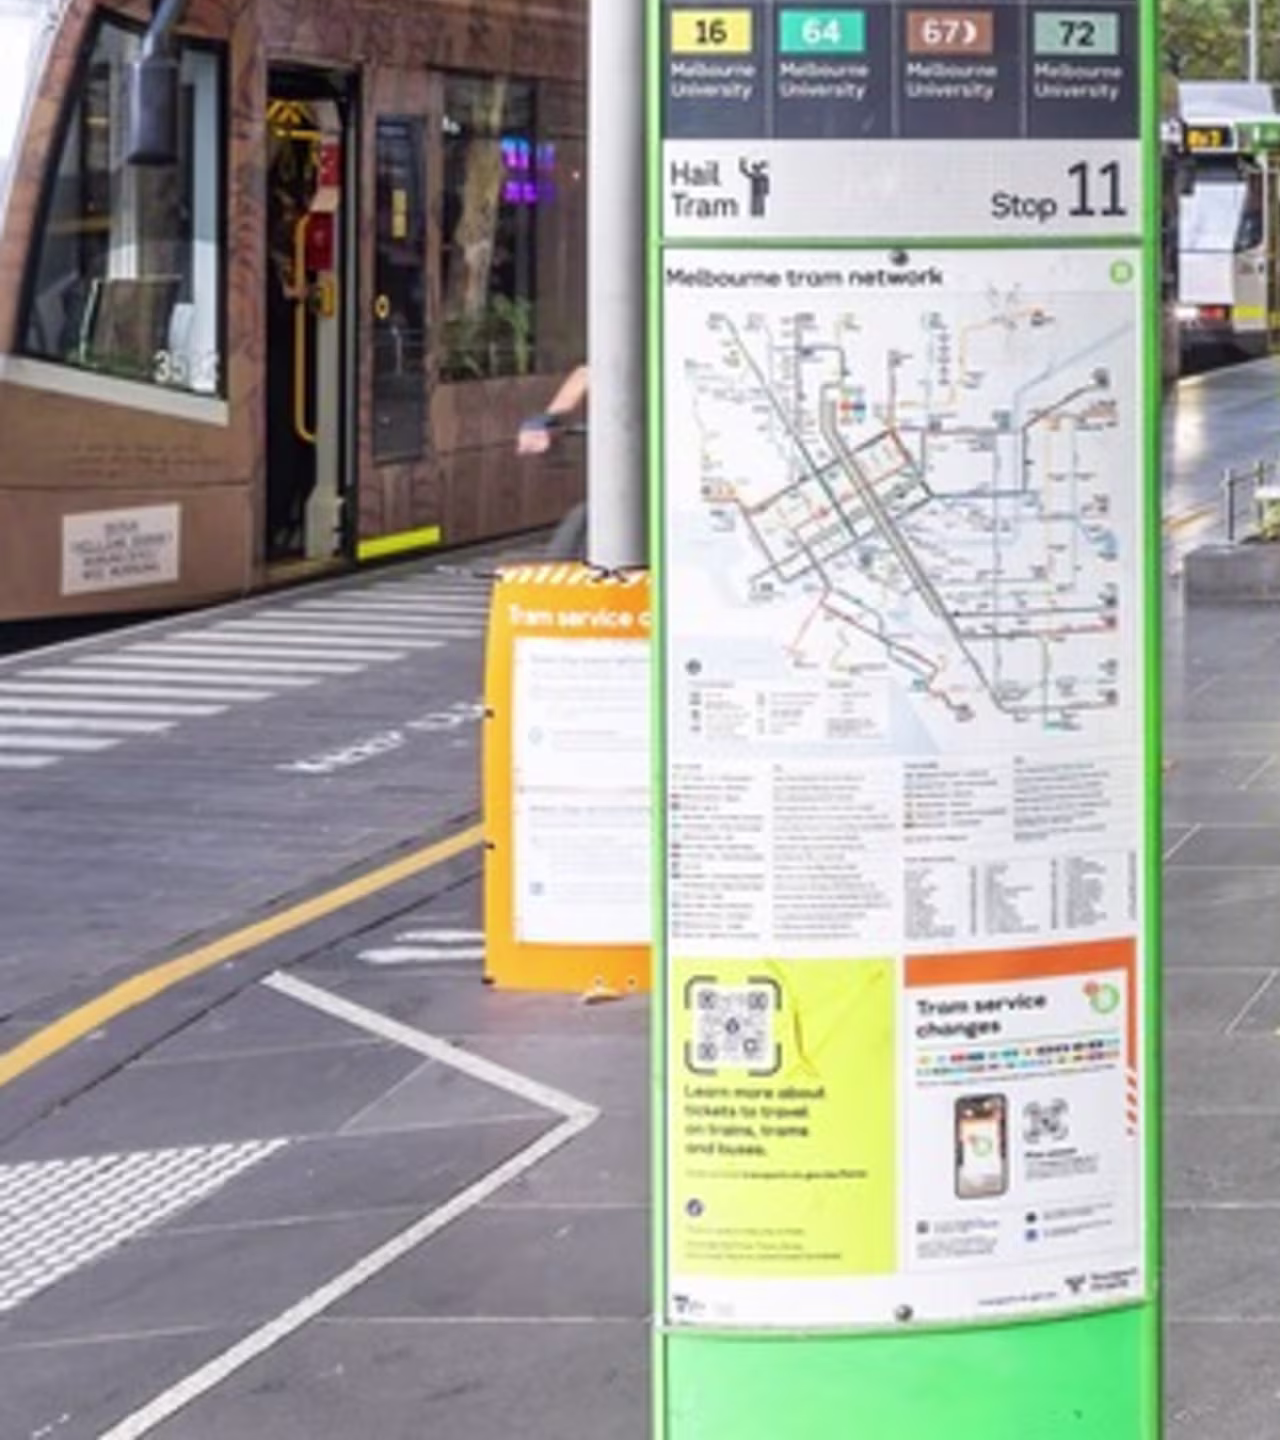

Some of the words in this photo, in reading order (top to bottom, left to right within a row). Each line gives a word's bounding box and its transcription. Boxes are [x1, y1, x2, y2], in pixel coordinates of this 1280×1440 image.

[695, 18, 728, 45] 16
[802, 18, 842, 45] 64
[1058, 20, 1096, 48] 72
[671, 62, 756, 79] Melbourne
[779, 62, 870, 79] Melbourne
[906, 62, 998, 79] Melbourne
[1034, 62, 1123, 79] Melbourne
[671, 81, 753, 102] University
[780, 81, 868, 102] University
[906, 81, 994, 102] University
[1034, 81, 1119, 102] University
[670, 160, 721, 187] Hail
[991, 190, 1058, 223] Stop
[1066, 161, 1128, 218] 11
[671, 194, 739, 219] Tram
[665, 267, 781, 288] Melbourne
[785, 269, 843, 288] tram
[848, 266, 943, 288] network
[509, 605, 552, 626] Tram
[557, 608, 634, 629] service
[916, 998, 969, 1015] Tram
[974, 993, 1047, 1013] service
[916, 1020, 1002, 1039] changes
